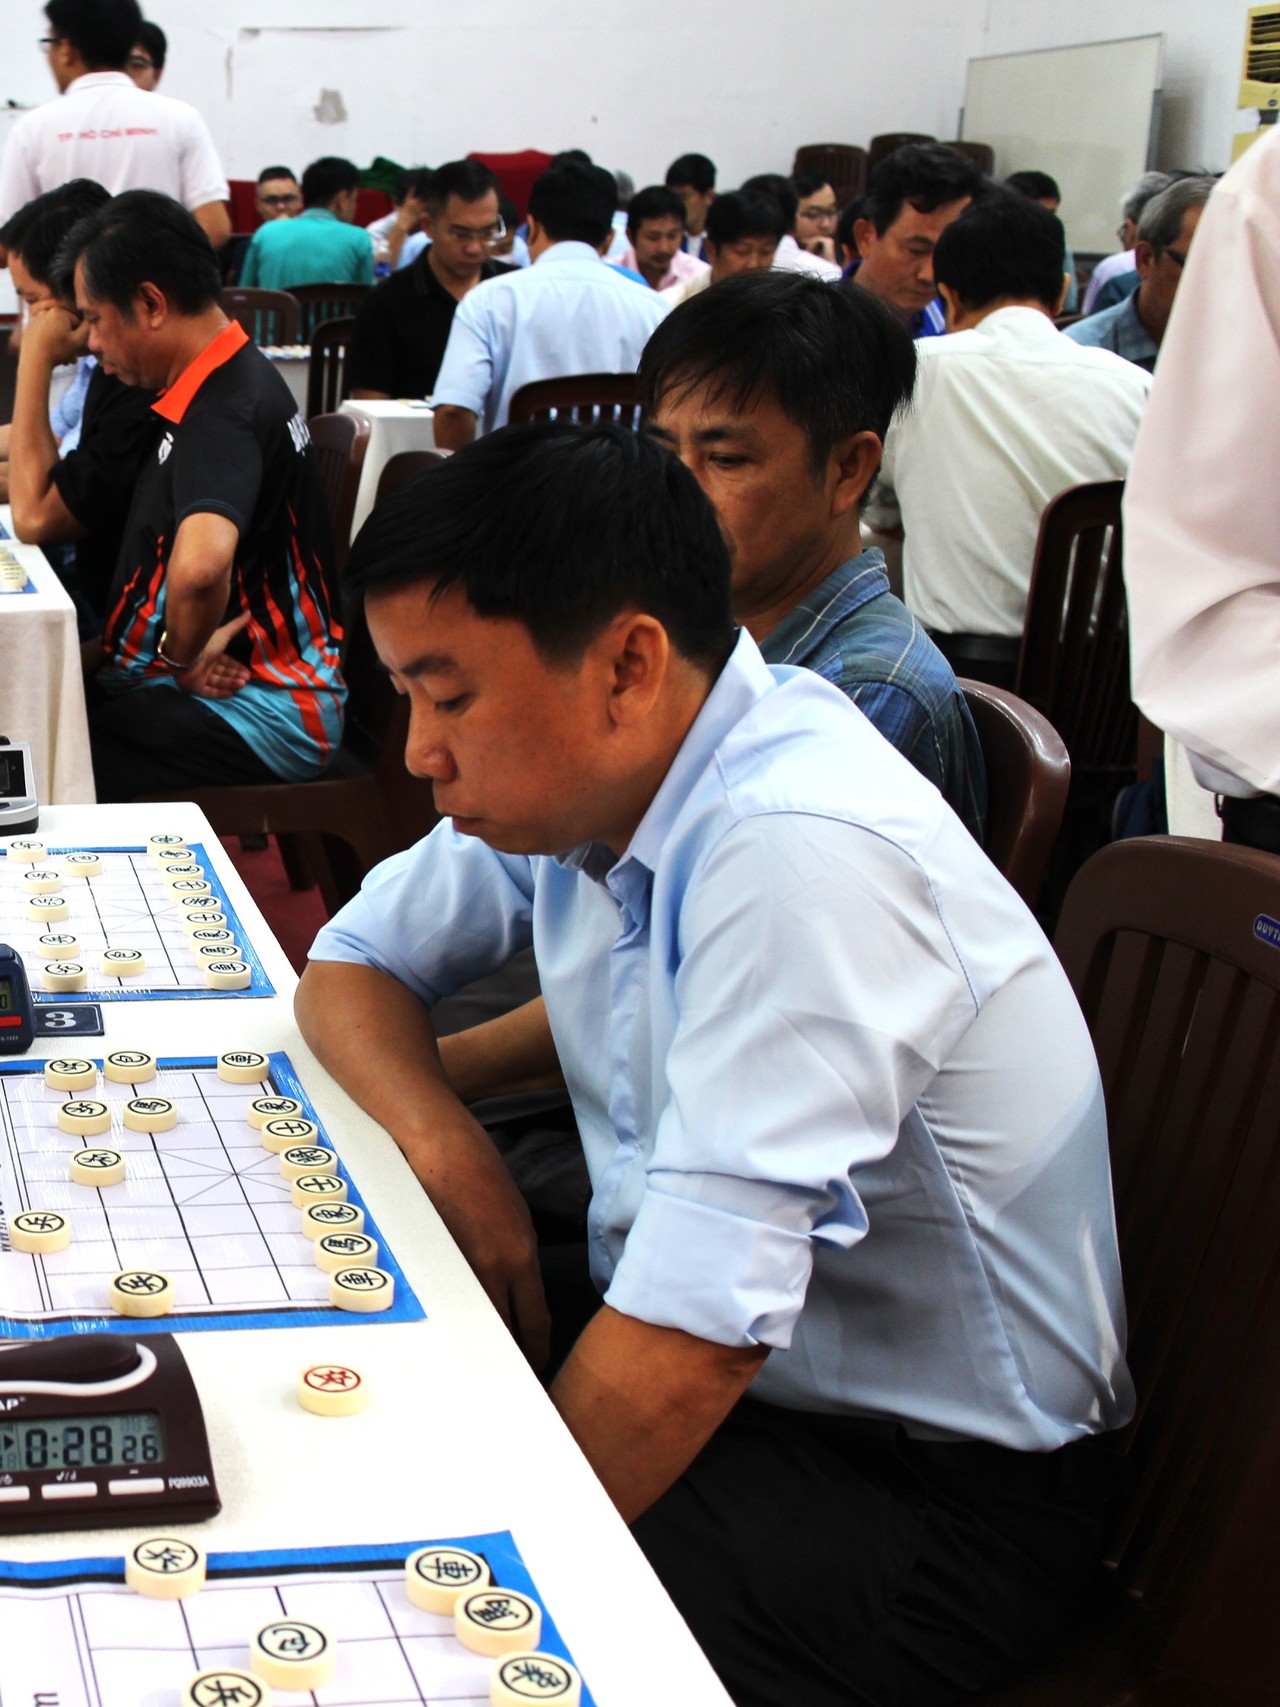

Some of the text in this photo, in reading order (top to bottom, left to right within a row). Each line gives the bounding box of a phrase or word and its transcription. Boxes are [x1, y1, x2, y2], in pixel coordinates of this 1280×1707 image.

[45, 1011, 76, 1028] 3
[25, 1425, 158, 1468] 0:28 26
